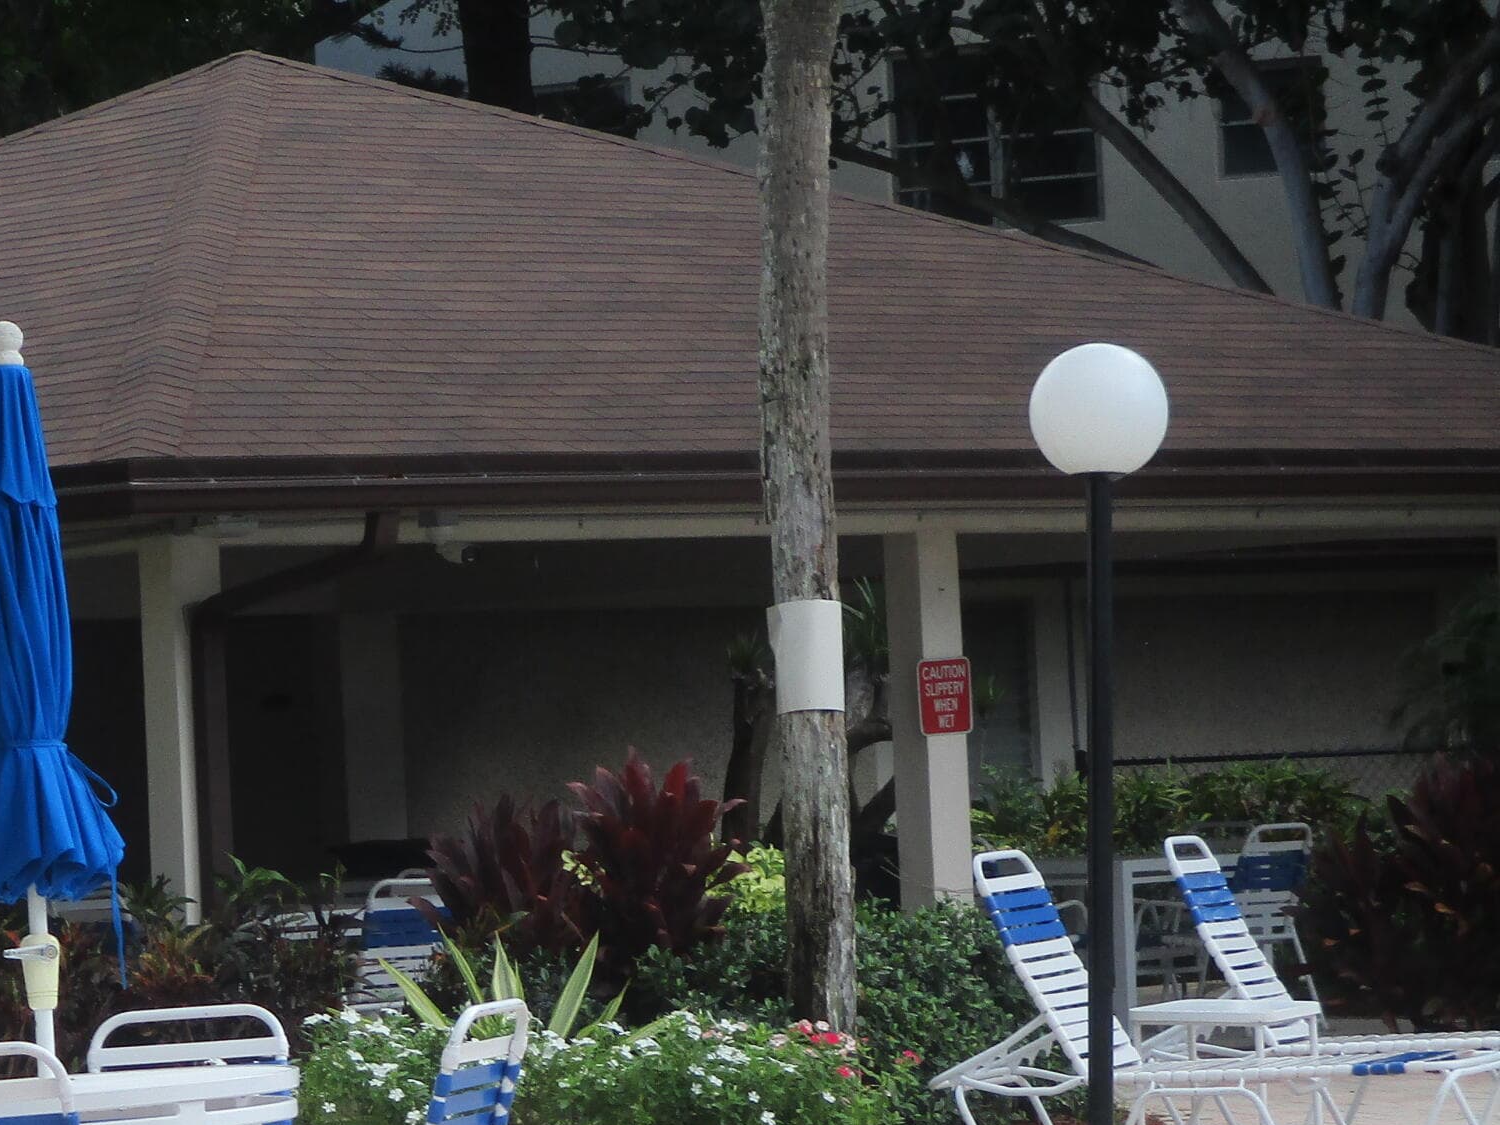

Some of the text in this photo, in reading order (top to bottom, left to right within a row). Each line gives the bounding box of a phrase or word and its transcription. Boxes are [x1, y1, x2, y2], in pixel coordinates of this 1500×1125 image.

[922, 664, 966, 680] CAUTION
[924, 681, 964, 697] SLIPPERY
[934, 698, 958, 712] WHEN
[938, 714, 955, 728] WET
